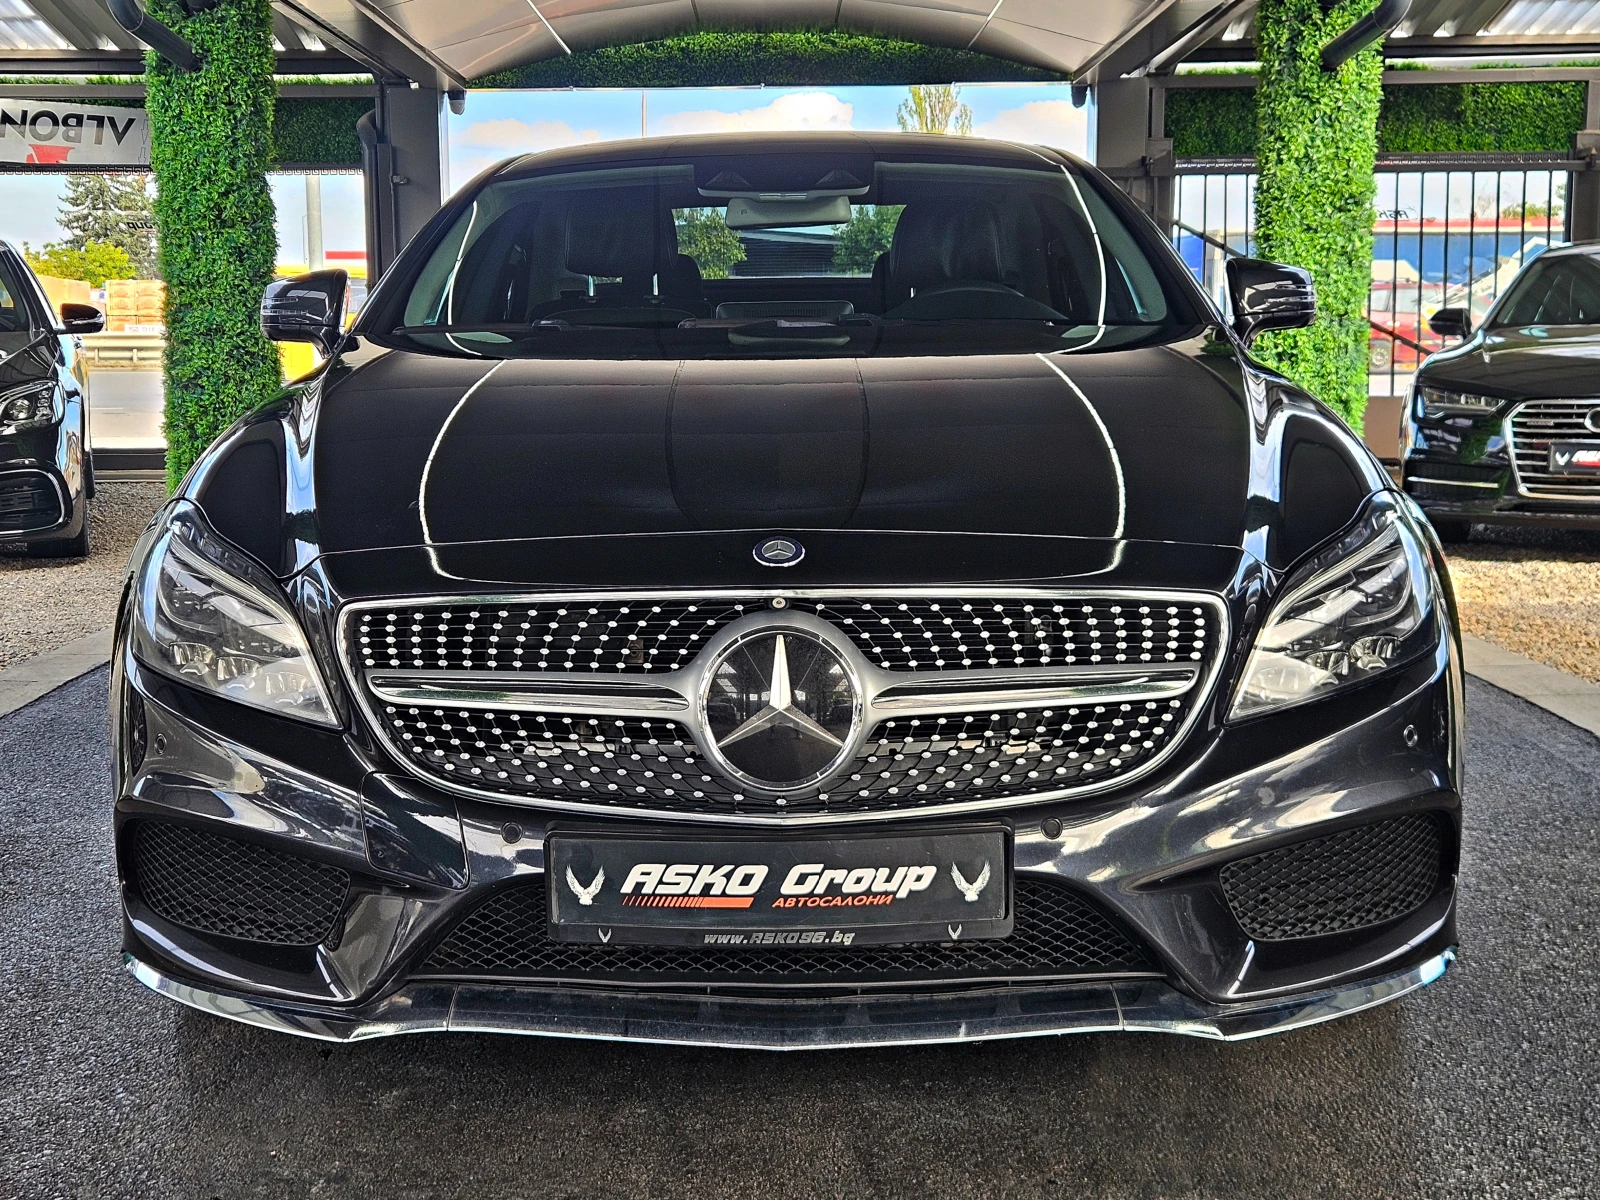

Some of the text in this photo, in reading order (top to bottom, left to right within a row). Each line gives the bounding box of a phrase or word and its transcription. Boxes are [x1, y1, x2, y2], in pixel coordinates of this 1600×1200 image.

[620, 863, 938, 899] ASKO Group
[772, 894, 894, 909] АВТОСАЛОНИ
[703, 930, 856, 946] www.ASKO96.bg
